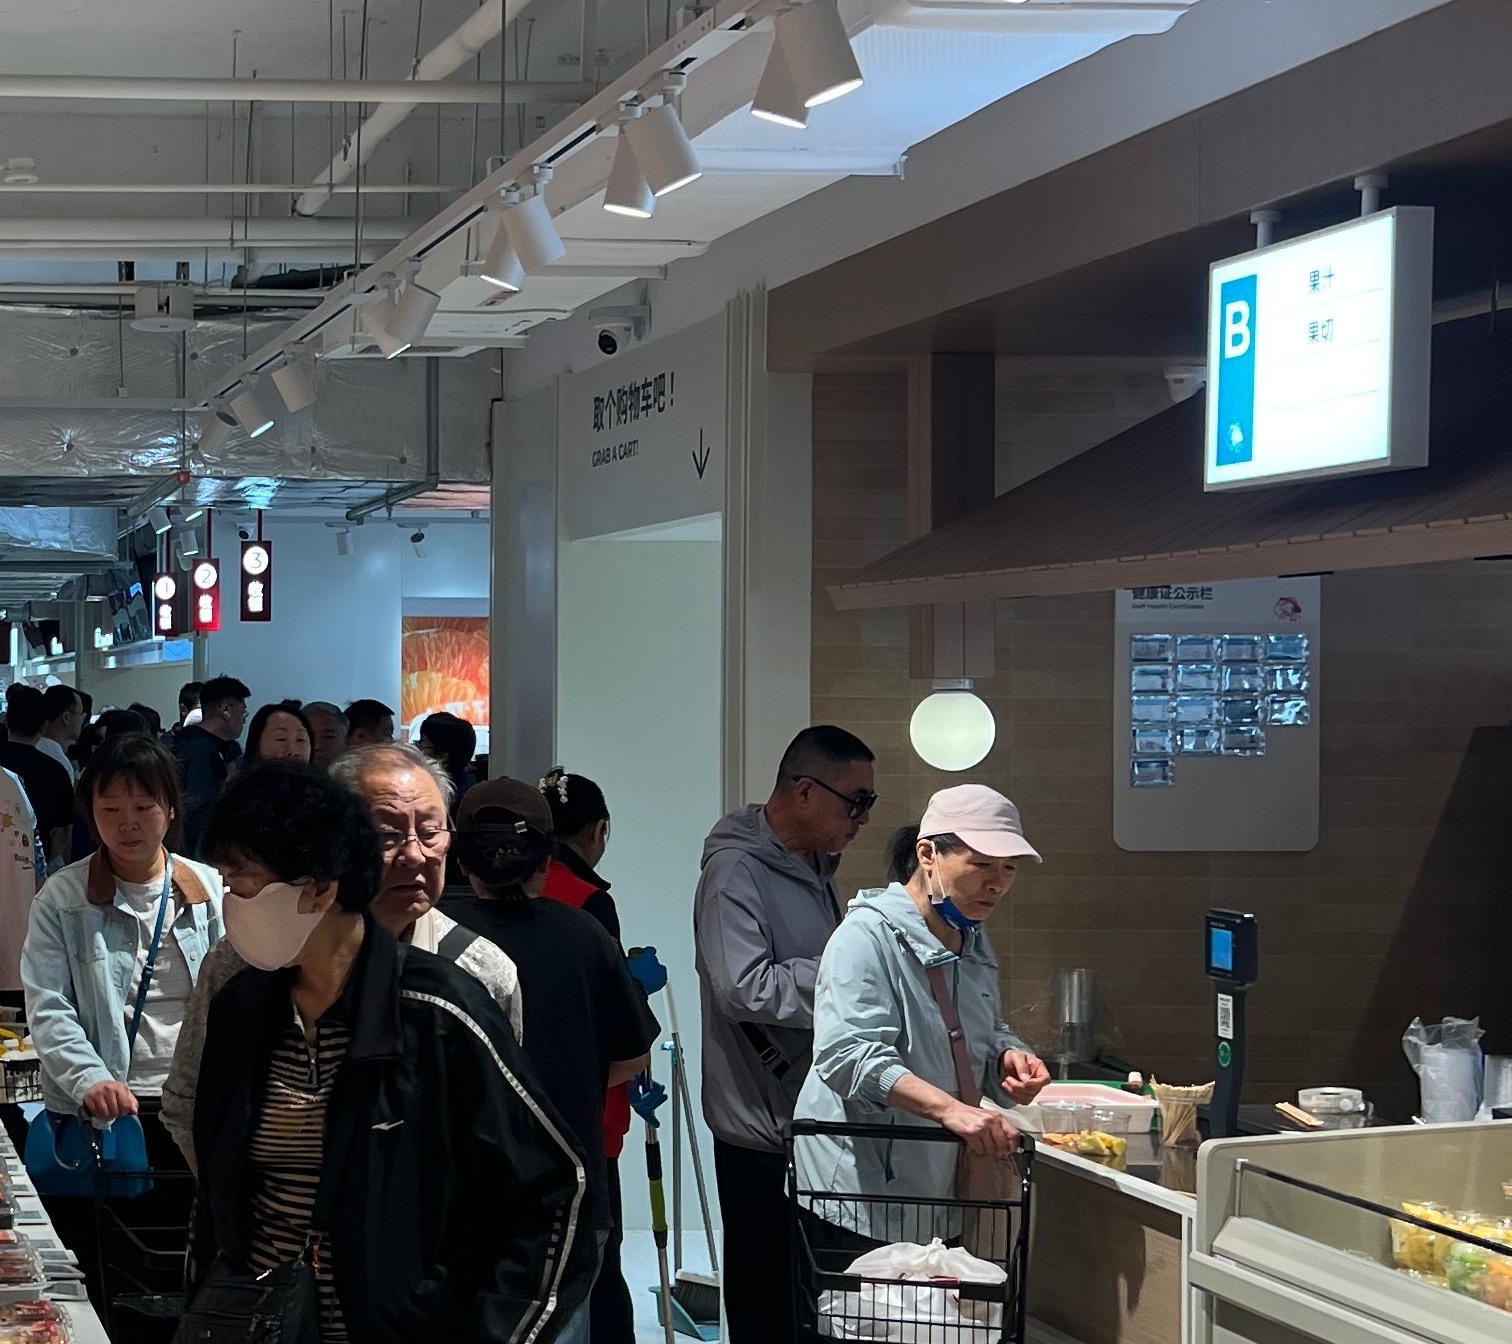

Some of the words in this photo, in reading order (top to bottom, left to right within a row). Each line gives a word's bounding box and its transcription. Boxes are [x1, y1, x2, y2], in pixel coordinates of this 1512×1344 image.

[1308, 266, 1335, 294] 果汁
[1224, 299, 1251, 359] B
[592, 448, 611, 467] GRAB
